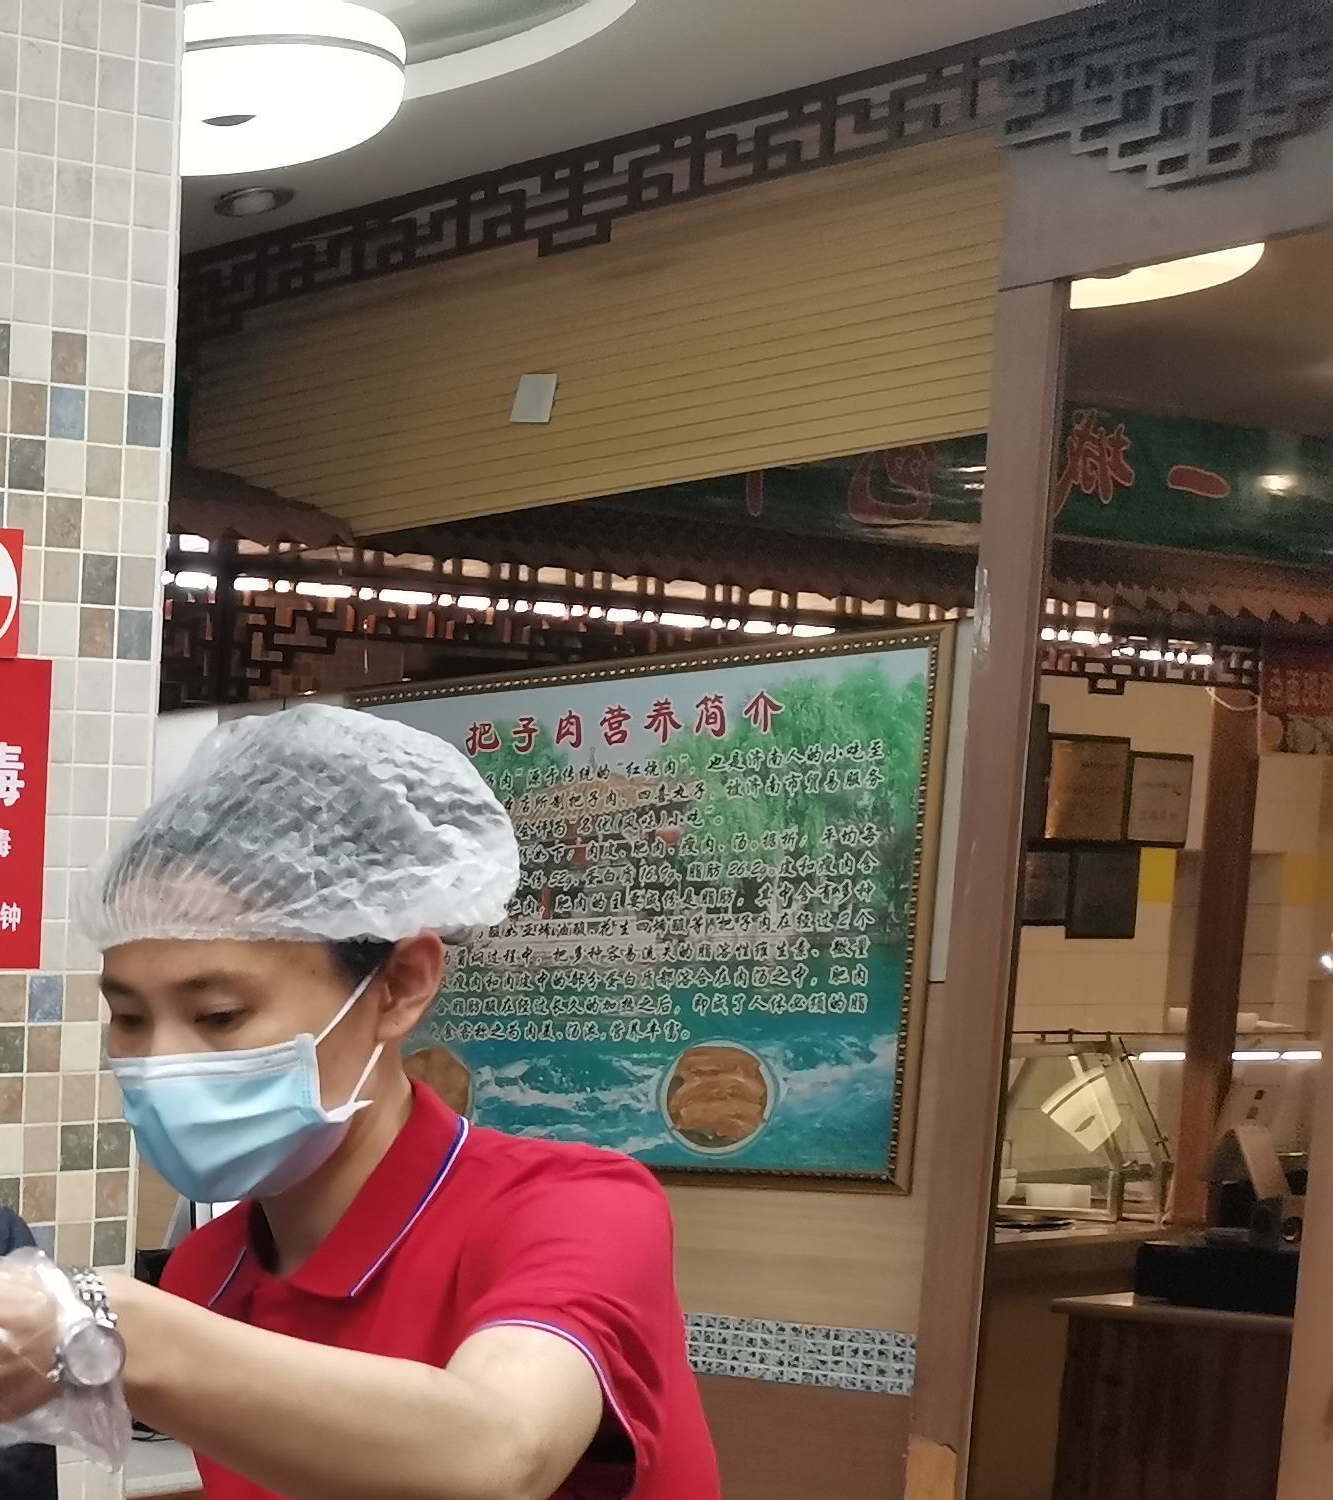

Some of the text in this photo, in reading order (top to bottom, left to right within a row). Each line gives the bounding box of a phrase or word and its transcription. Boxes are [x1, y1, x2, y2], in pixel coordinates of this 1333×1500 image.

[465, 690, 785, 756] 把子肉营养简介
